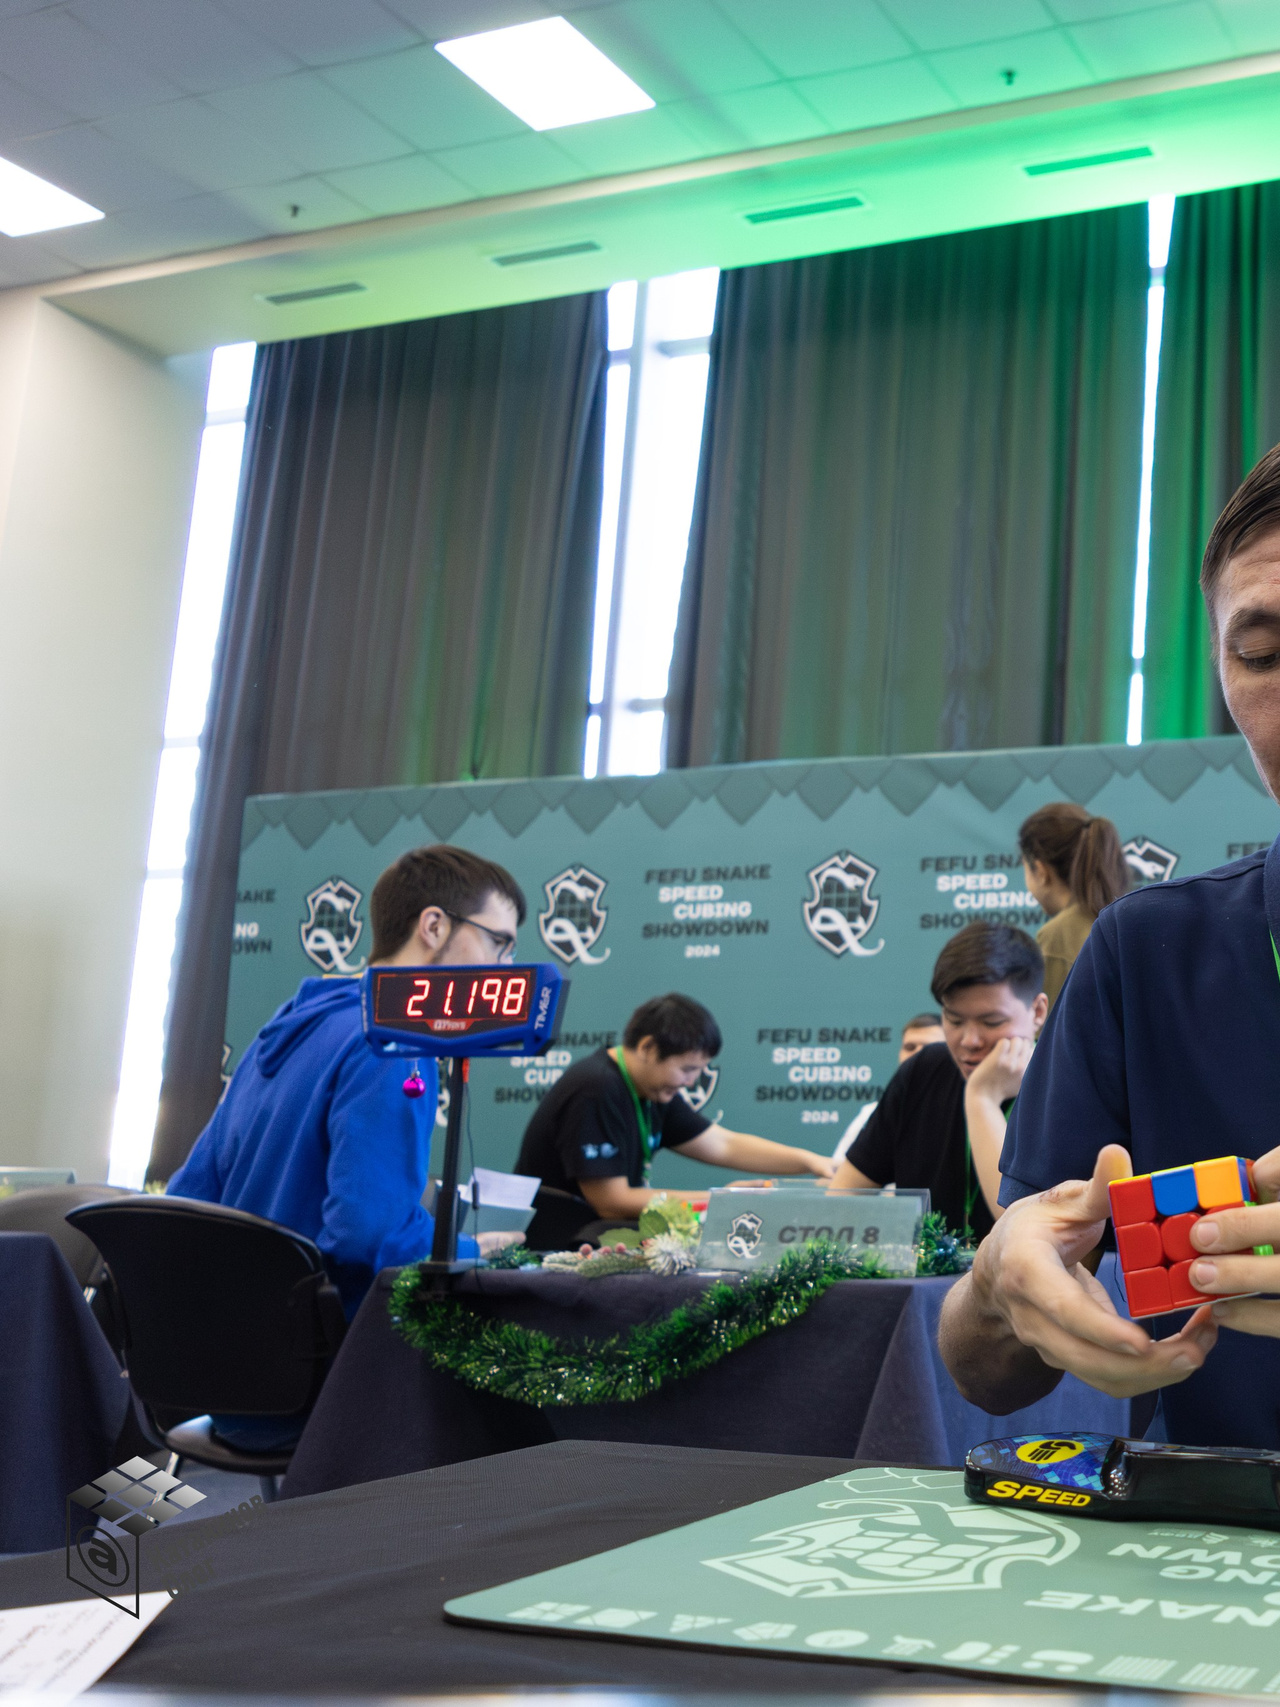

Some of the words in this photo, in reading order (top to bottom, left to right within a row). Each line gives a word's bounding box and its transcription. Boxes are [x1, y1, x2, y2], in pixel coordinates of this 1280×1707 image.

[920, 855, 977, 872] FEFU
[645, 867, 697, 884] FEFU
[702, 863, 772, 882] SNAKE
[936, 872, 1008, 892] SPEED
[658, 884, 724, 903] SPEED
[953, 891, 1039, 909] CUBING
[673, 901, 752, 920] CUBING
[642, 919, 769, 939] SHOWDOWN
[684, 944, 721, 958] 2024
[534, 986, 552, 1031] TIMER
[757, 1028, 812, 1044] FEFU
[818, 1026, 892, 1044] SNAKE
[510, 1050, 572, 1067] SPEED
[772, 1046, 841, 1065] SPEED
[788, 1065, 872, 1083] CUBING
[801, 1110, 839, 1123] 2024
[861, 1225, 880, 1245] 8
[986, 1480, 1091, 1507] SPEED
